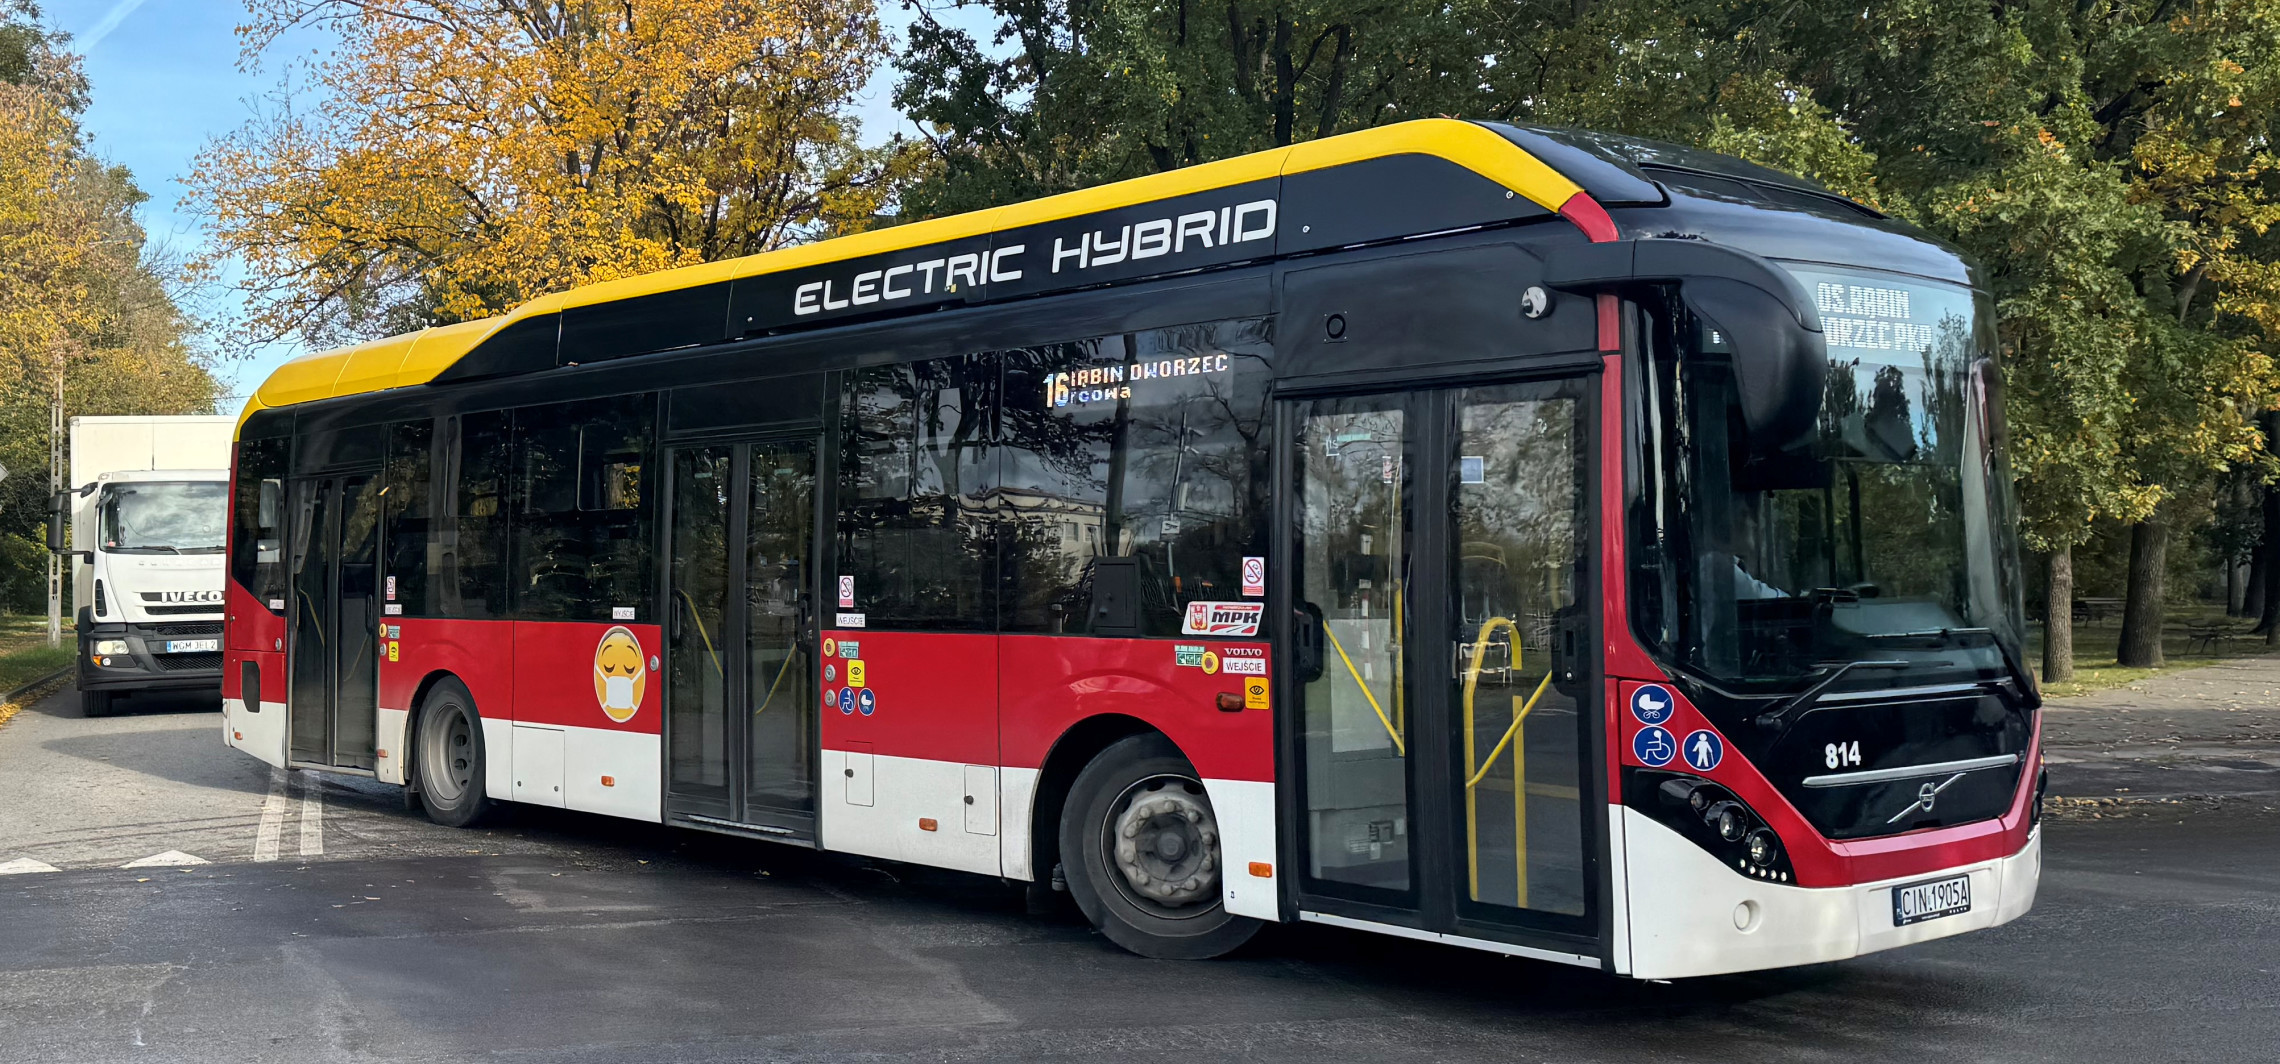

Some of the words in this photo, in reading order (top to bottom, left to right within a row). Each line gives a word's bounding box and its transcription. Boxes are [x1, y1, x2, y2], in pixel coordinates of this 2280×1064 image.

[794, 244, 1025, 316] ELECTRIC
[1052, 199, 1277, 274] HYBRID
[1820, 316, 1892, 351] ORZEC
[1893, 321, 1933, 353] PKP
[1129, 354, 1228, 381] DWORZEC
[1042, 372, 1070, 408] 16
[161, 590, 223, 603] IVECO
[1211, 611, 1260, 624] MPK
[1224, 647, 1263, 657] VOLVO
[1225, 659, 1262, 672] WEJŚCIE
[1825, 740, 1862, 770] 814
[1932, 880, 1968, 910] 1905A
